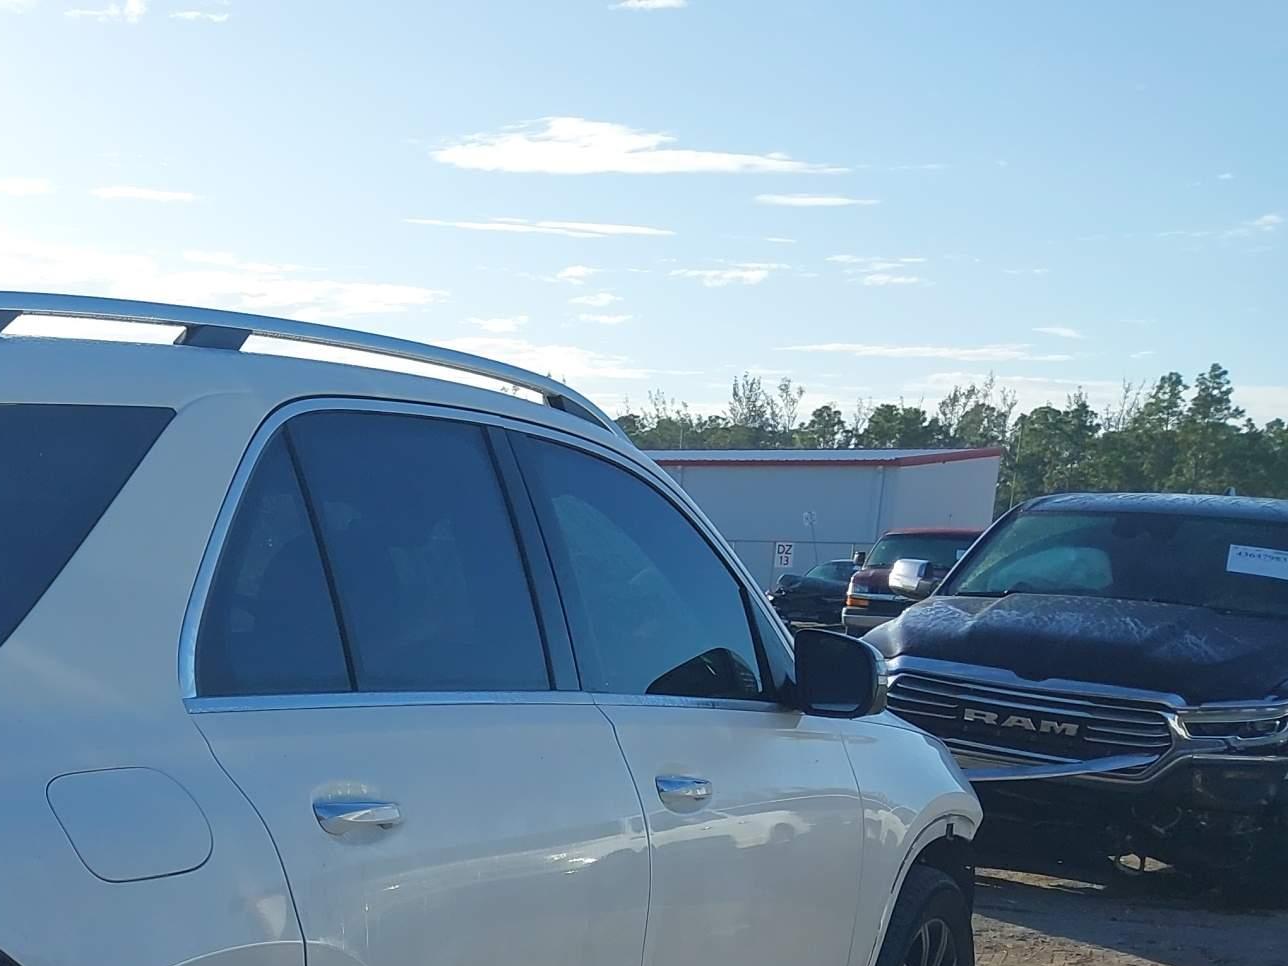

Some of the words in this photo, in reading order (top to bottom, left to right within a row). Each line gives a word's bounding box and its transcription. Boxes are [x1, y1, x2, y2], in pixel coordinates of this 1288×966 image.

[777, 544, 793, 555] DZ
[779, 555, 789, 566] 13
[963, 708, 1079, 737] RAM
